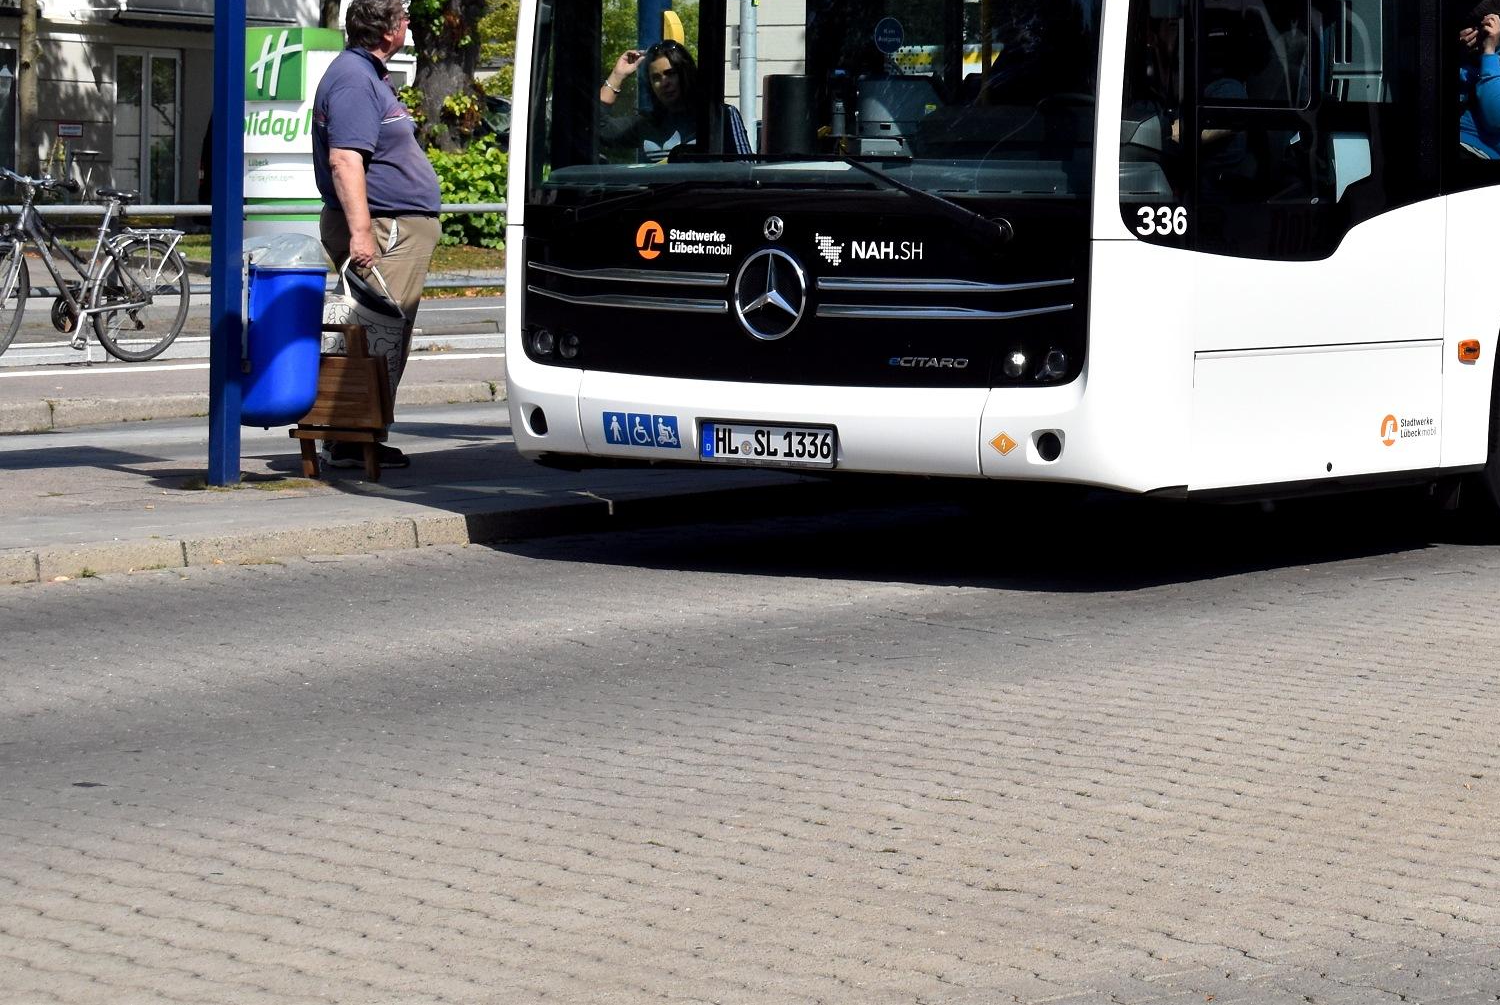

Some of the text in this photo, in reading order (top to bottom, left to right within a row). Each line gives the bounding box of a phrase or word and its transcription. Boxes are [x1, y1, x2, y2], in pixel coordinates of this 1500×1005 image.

[1136, 206, 1188, 236] 336
[669, 228, 726, 243] Stadtwerke
[669, 241, 732, 256] Lübeck mobil
[851, 241, 923, 261] NAH.SH
[889, 356, 969, 369] eCITARO
[1400, 417, 1434, 428] Stadtwerke
[706, 428, 832, 459] D HL SL 1336
